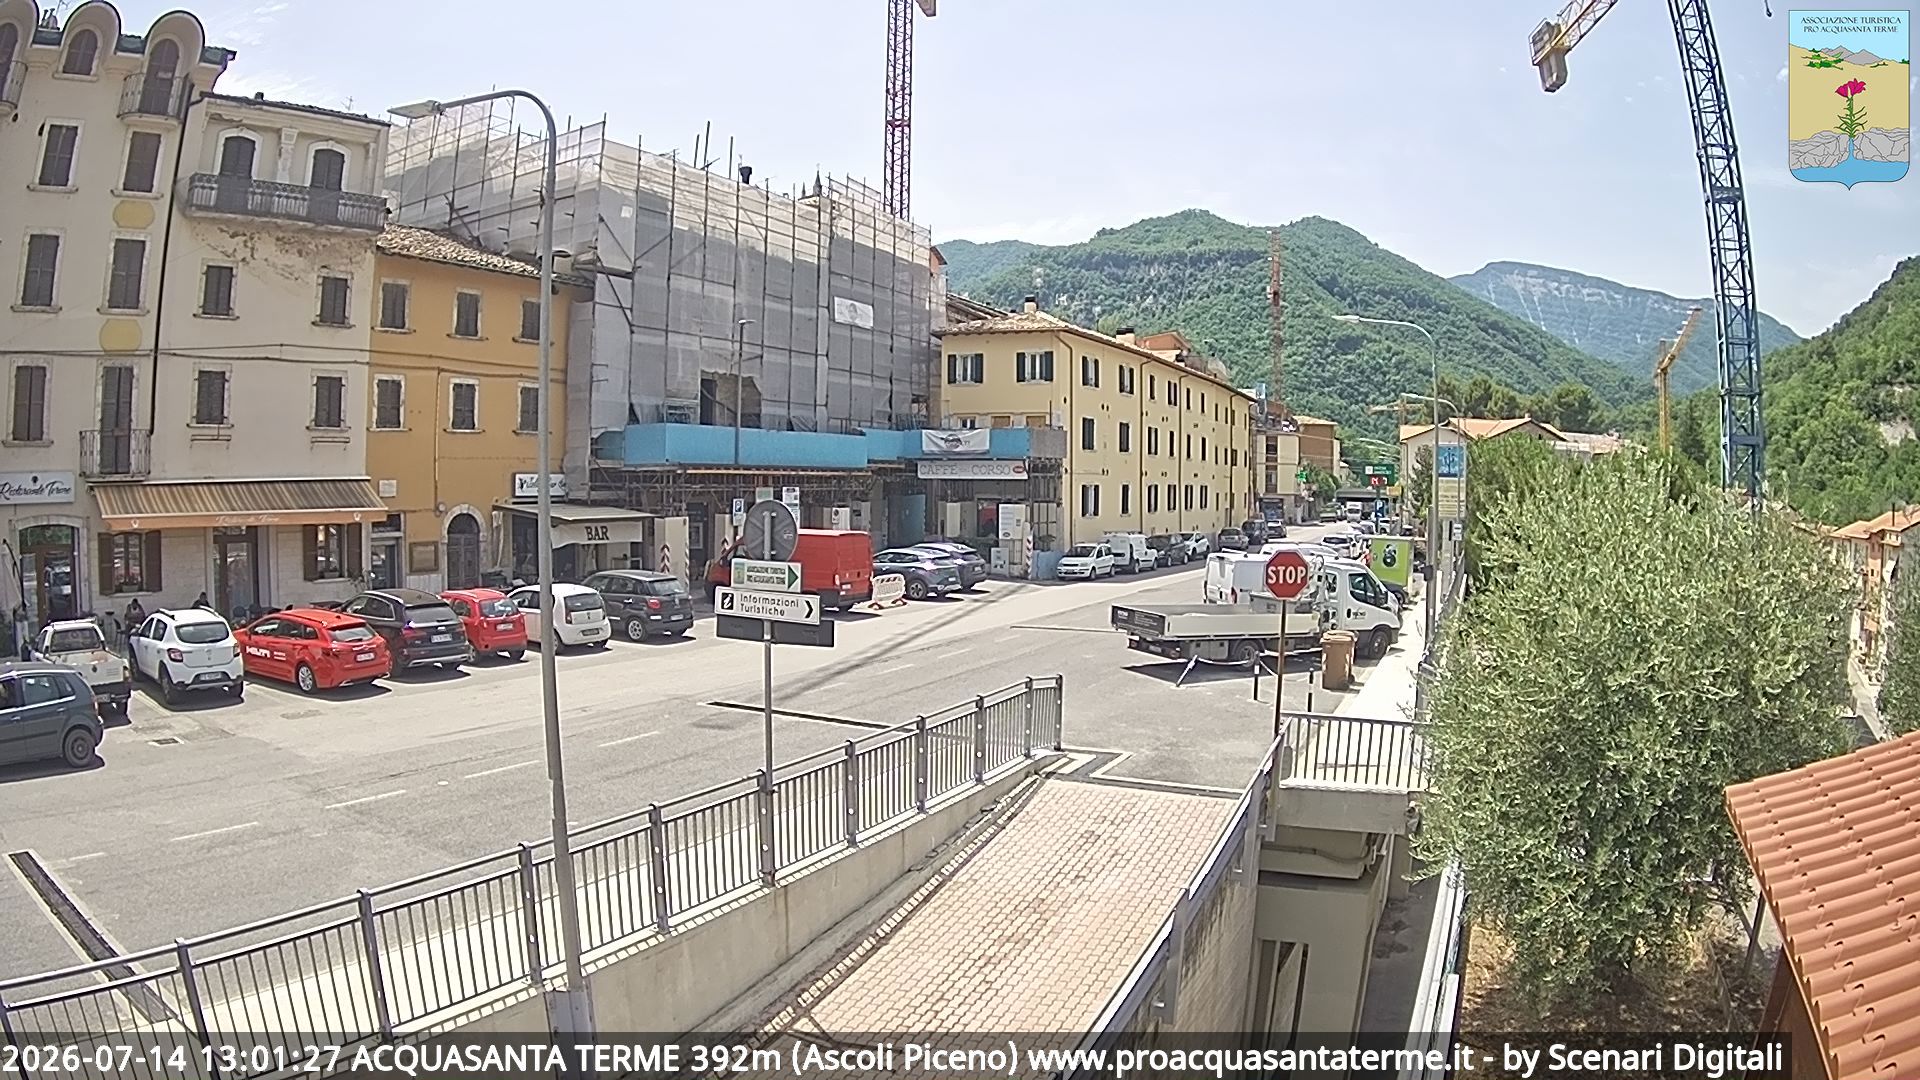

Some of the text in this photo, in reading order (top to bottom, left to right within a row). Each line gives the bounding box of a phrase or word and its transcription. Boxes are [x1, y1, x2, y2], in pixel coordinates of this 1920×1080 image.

[971, 464, 1010, 475] CORSO
[585, 525, 609, 541] BAR
[1267, 565, 1306, 584] STOP
[740, 594, 799, 607] Informazioni
[740, 604, 785, 616] Turistiche
